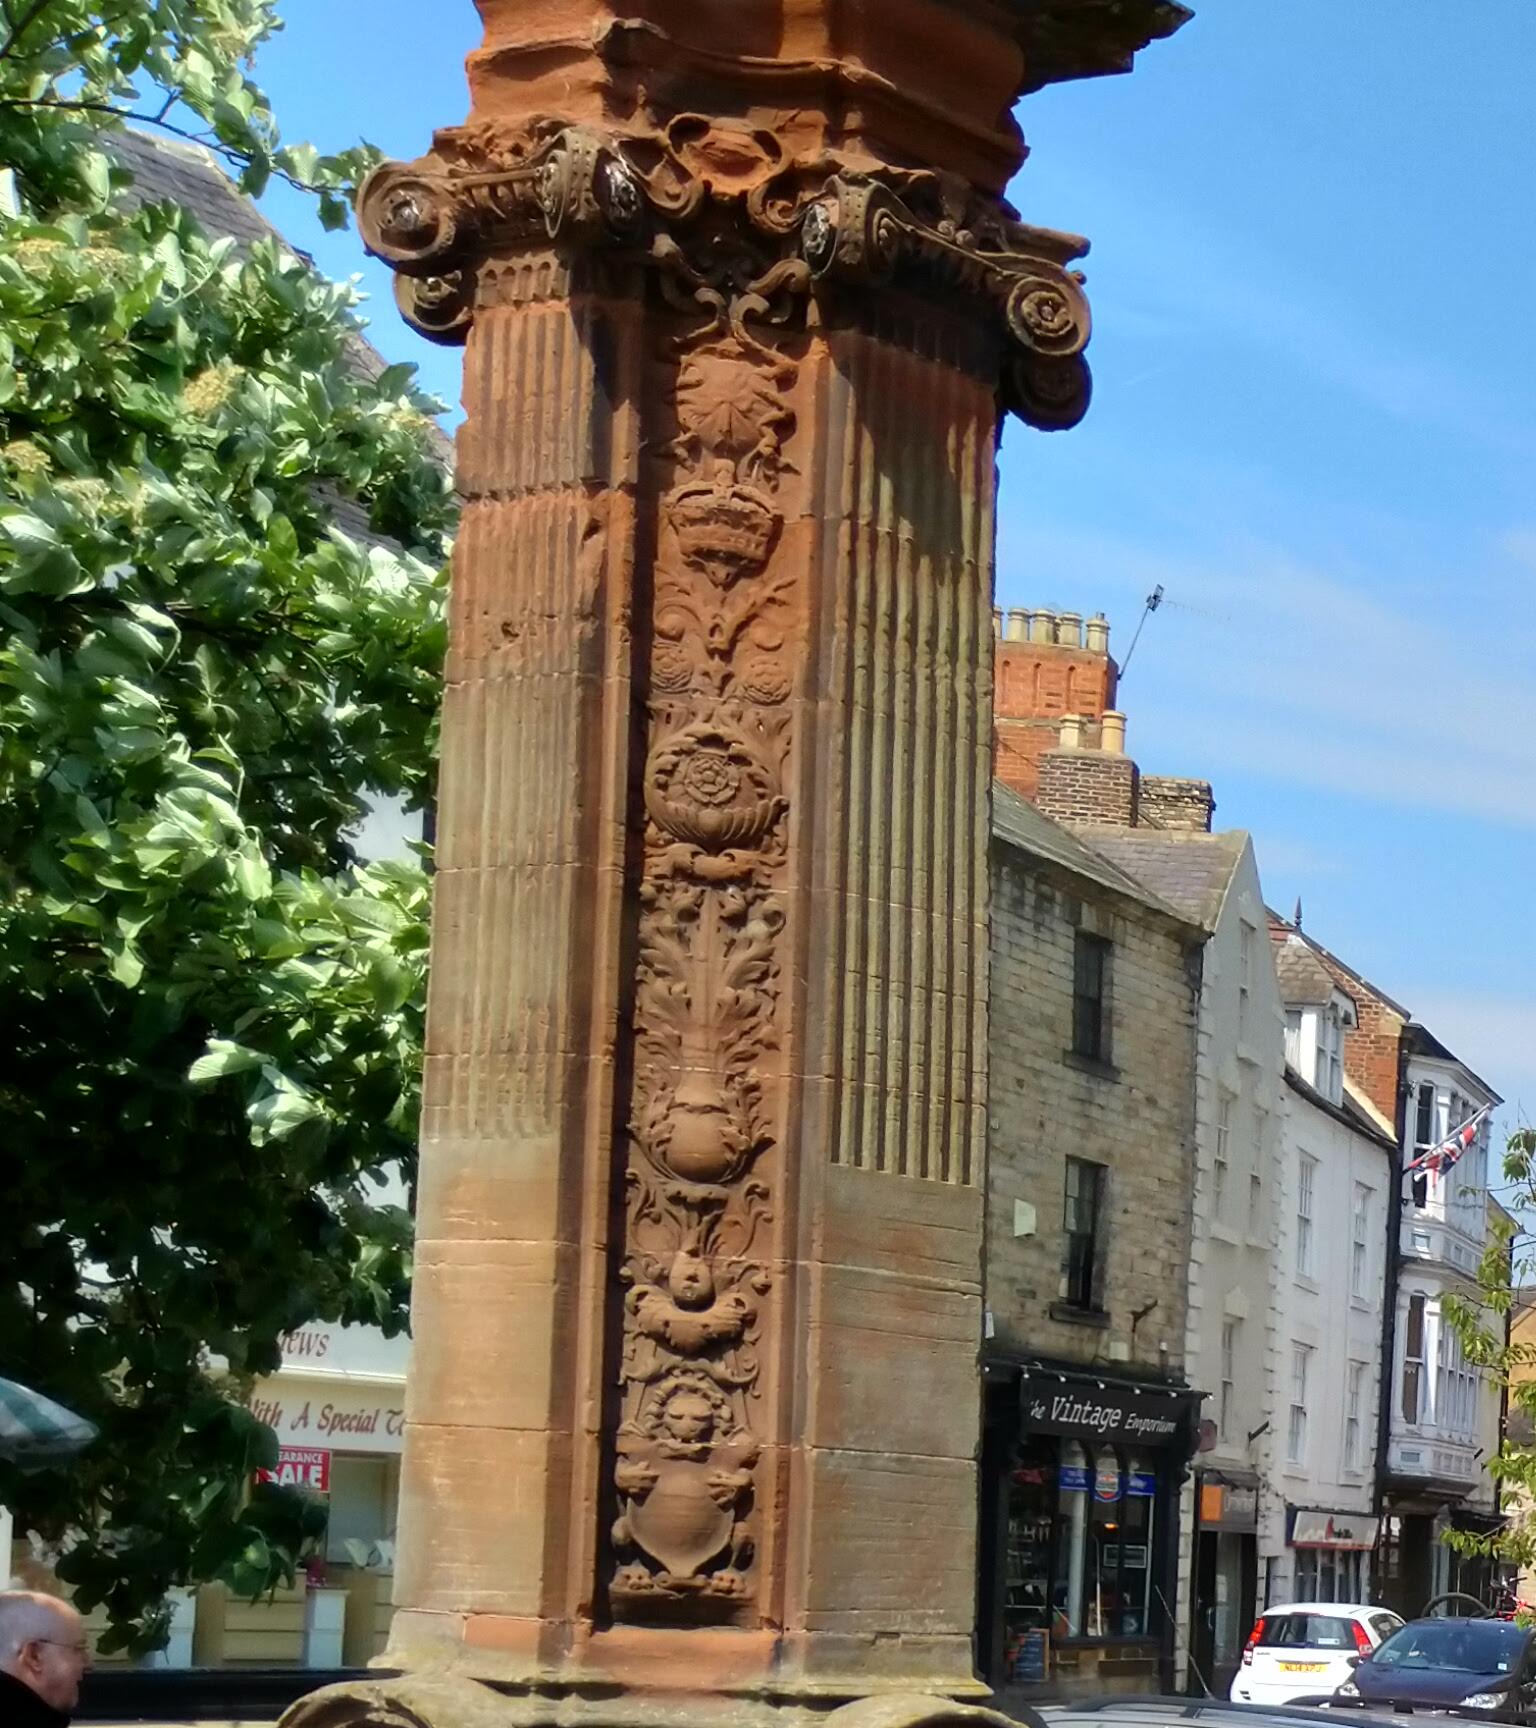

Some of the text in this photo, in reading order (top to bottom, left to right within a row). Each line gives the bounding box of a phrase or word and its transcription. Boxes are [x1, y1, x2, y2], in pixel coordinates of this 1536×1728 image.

[290, 1402, 380, 1436] A Special
[1050, 1394, 1177, 1436] Vintage Emporium
[278, 1451, 323, 1463] EARANCE
